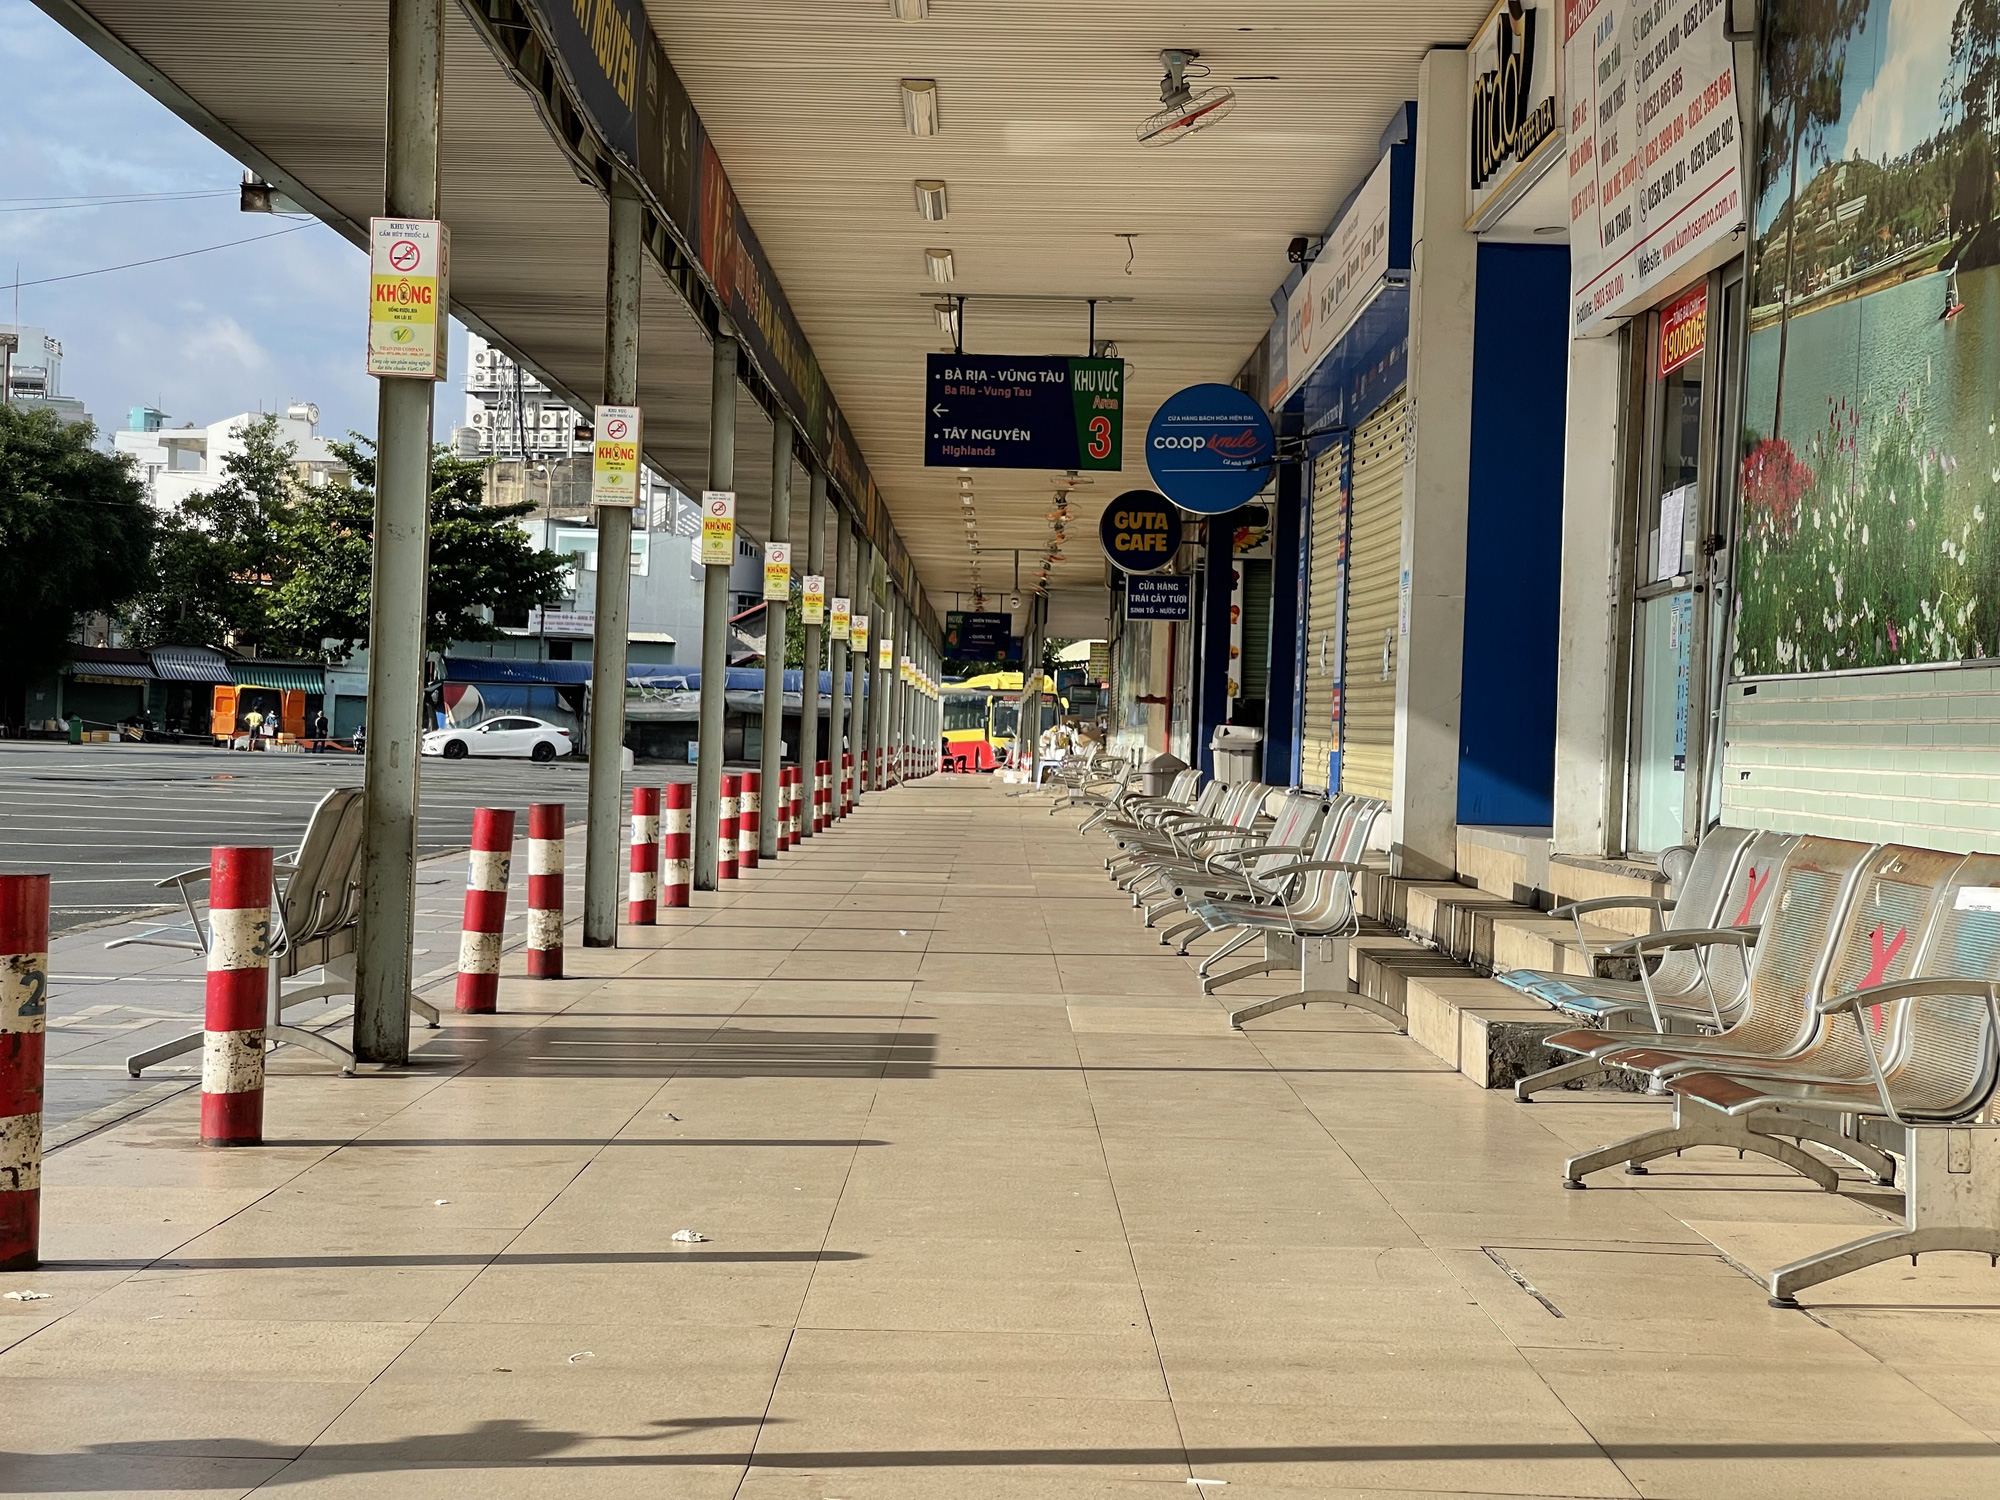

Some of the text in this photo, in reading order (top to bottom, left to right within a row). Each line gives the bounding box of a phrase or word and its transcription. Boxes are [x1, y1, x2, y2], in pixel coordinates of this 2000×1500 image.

[1683, 3, 1699, 39] 0252
[591, 0, 637, 113] NGUYÊN
[1671, 67, 1684, 99] 665
[1599, 94, 1613, 129] PHAN
[1688, 94, 1703, 130] 0262
[1703, 80, 1720, 116] 3956
[1719, 67, 1732, 102] 956
[1513, 97, 1554, 163] COFFEE & TEA
[1647, 179, 1661, 212] 0258
[1661, 167, 1675, 200] 3901
[1675, 157, 1686, 188] 901
[1690, 140, 1706, 175] 0258
[1705, 126, 1721, 162] 3902
[1721, 115, 1734, 149] 902
[1604, 204, 1632, 248] NHA TRANG
[1637, 189, 1738, 279] Website: www.kumhosamco.com.vn
[376, 277, 432, 305] KHÔNG
[1593, 289, 1606, 313] 0903
[1605, 280, 1615, 304] 580
[1614, 273, 1625, 296] 000
[944, 367, 962, 381] BÀ
[966, 369, 988, 384] RỊA
[997, 368, 1037, 383] VŨNG
[1039, 369, 1065, 383] TÀU
[1074, 367, 1120, 398] KHU VỰC
[944, 385, 959, 396] Ba
[960, 385, 976, 396] Ria
[983, 386, 1012, 398] Vung
[1013, 386, 1032, 397] Tau
[1092, 395, 1119, 410] Area
[942, 426, 1031, 441] TÂY NGUYÊN
[1088, 415, 1112, 460] 3
[1153, 428, 1260, 453] co.op smile
[599, 443, 634, 461] KHÔNG
[942, 445, 996, 457] Highlands
[705, 518, 732, 532] KHÔNG
[1114, 511, 1169, 530] GUTA
[1115, 532, 1168, 552] CAFE
[1130, 592, 1149, 603] TRÁI
[1150, 593, 1167, 603] CÂY
[1138, 579, 1179, 591] CỬA HÀNG
[1130, 606, 1145, 614] SINH
[1146, 606, 1155, 614] TỐ
[1177, 606, 1187, 615] ÉP
[17, 969, 46, 1017] 2
